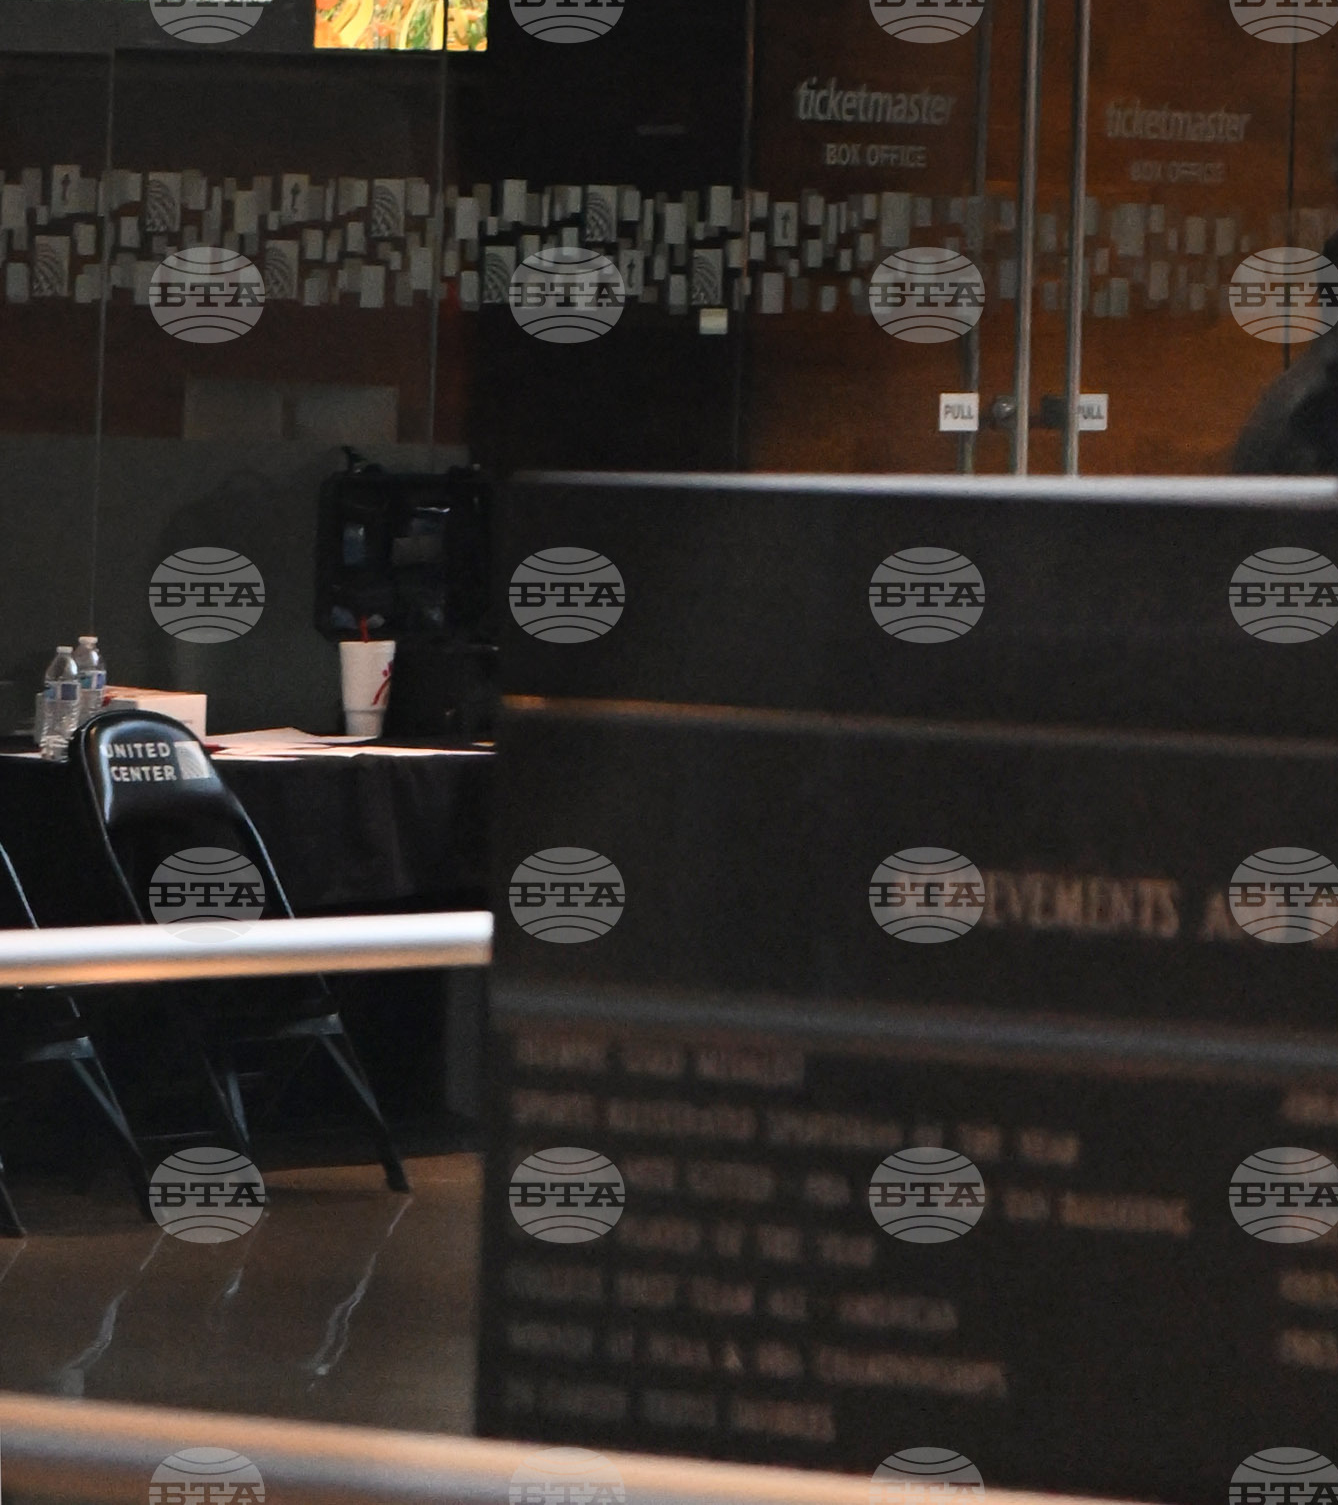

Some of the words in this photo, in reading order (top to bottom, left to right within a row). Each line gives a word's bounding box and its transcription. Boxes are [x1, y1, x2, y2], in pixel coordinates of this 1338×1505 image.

[796, 77, 954, 126] ticketmaster
[1105, 98, 1253, 142] ticketmaster
[826, 143, 860, 166] BOX
[866, 144, 928, 169] OFFICE
[943, 403, 974, 421] PULL
[103, 740, 171, 760] UNITED
[111, 764, 178, 783] CENTER
